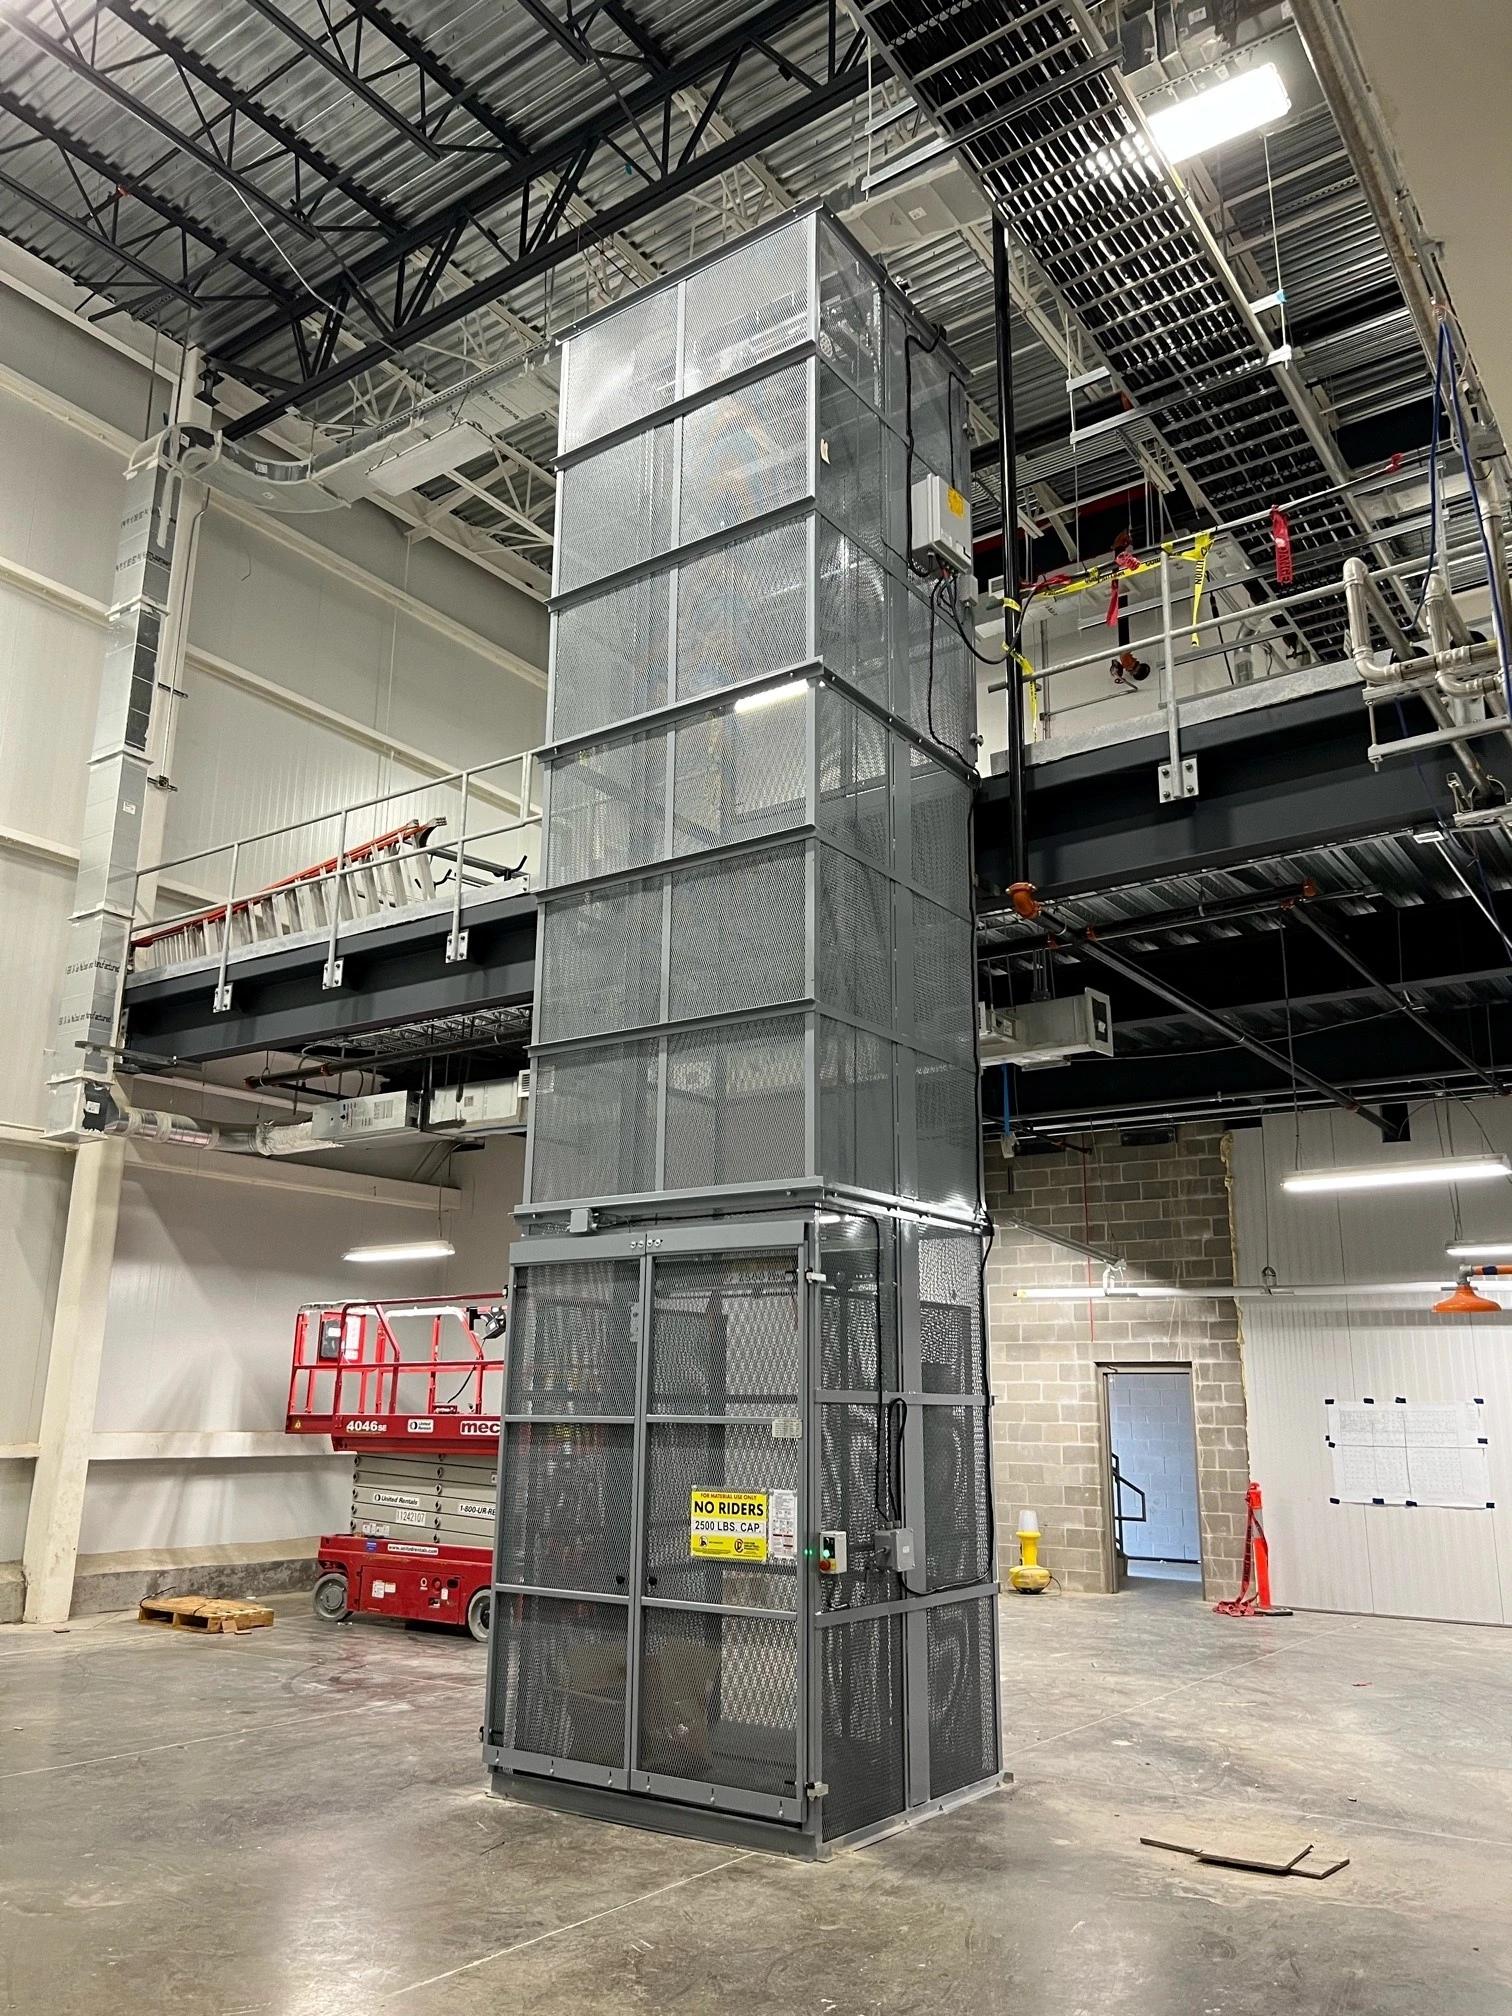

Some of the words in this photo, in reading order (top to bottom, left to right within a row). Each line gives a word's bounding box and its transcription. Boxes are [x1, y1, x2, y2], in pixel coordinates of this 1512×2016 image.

[381, 1495, 398, 1503] United
[399, 1497, 418, 1505] Rentals
[460, 1504, 496, 1516] 1-800-UR-RE
[694, 1500, 715, 1514] NO
[718, 1501, 764, 1517] RIDERS
[695, 1520, 715, 1531] 2500
[717, 1521, 738, 1532] LBS.
[740, 1522, 762, 1533] CAP.
